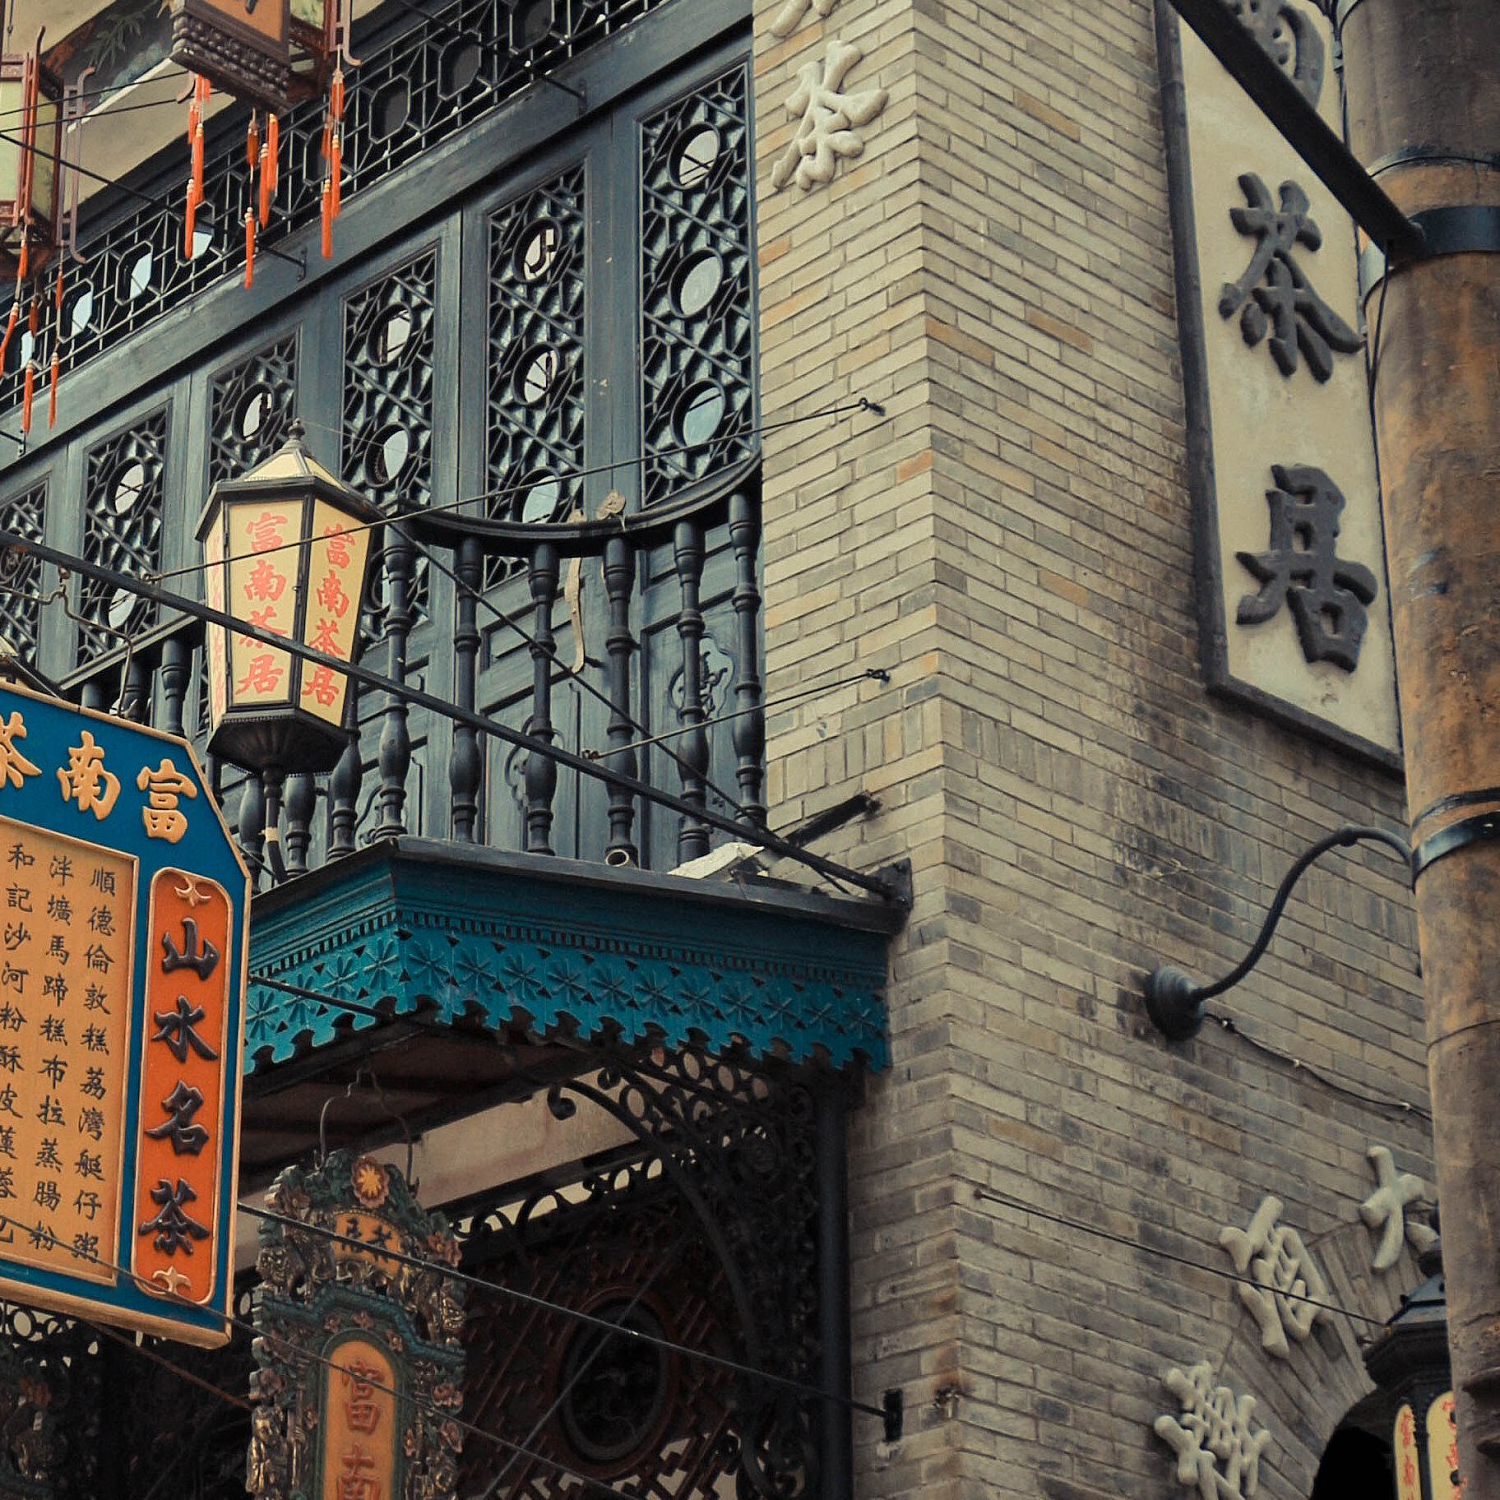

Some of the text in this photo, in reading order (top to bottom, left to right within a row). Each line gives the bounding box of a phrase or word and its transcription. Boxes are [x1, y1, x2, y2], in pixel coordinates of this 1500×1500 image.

[235, 511, 289, 696] 富南茶居
[302, 523, 356, 707] 富南茶居
[138, 918, 220, 1258] 山水名茶
